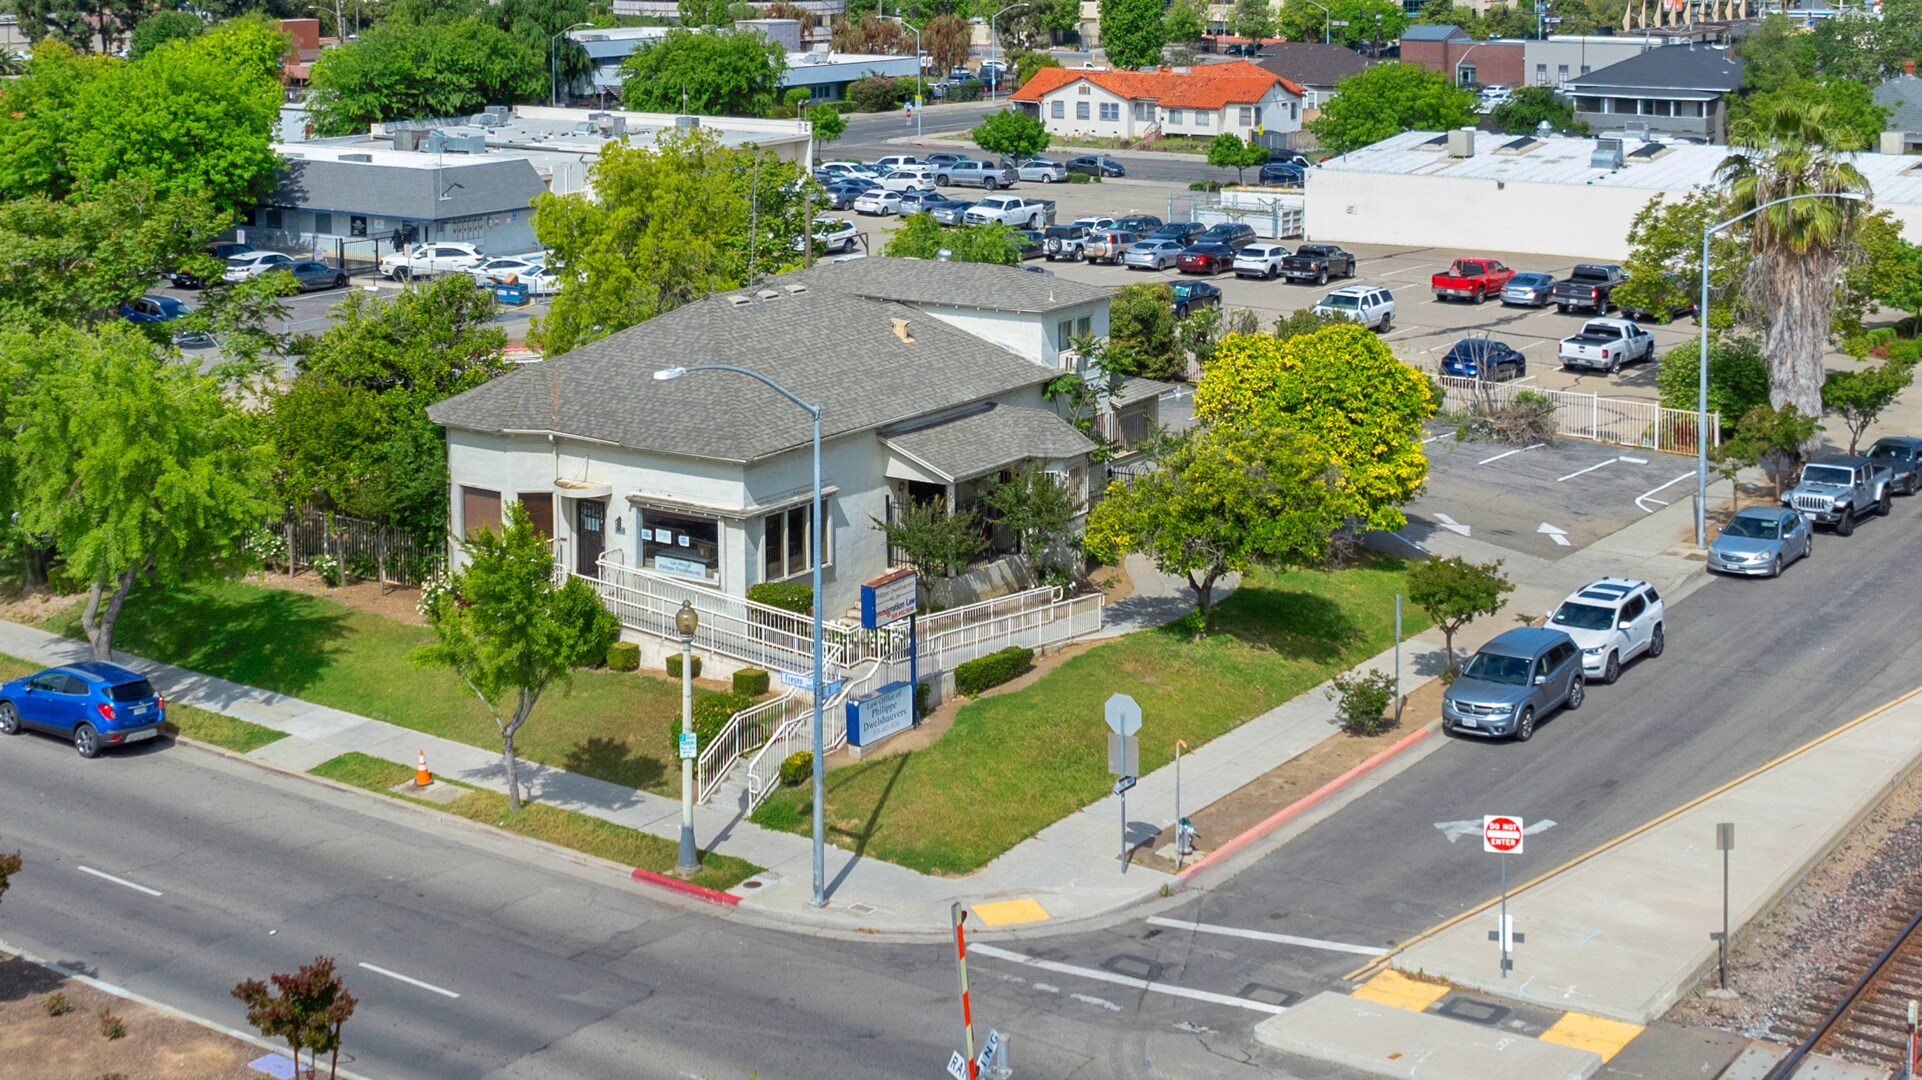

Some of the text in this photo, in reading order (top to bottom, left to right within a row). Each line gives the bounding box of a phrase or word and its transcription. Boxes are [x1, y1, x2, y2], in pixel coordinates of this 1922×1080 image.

[906, 598, 915, 606] Law
[785, 674, 803, 685] Fresno
[867, 701, 877, 710] Law
[878, 695, 895, 705] Office
[871, 702, 898, 718] Philippe
[863, 708, 907, 733] Dwelshauvers
[1502, 823, 1517, 831] NOT
[1491, 838, 1515, 846] ENTER
[980, 1033, 998, 1068] ING
